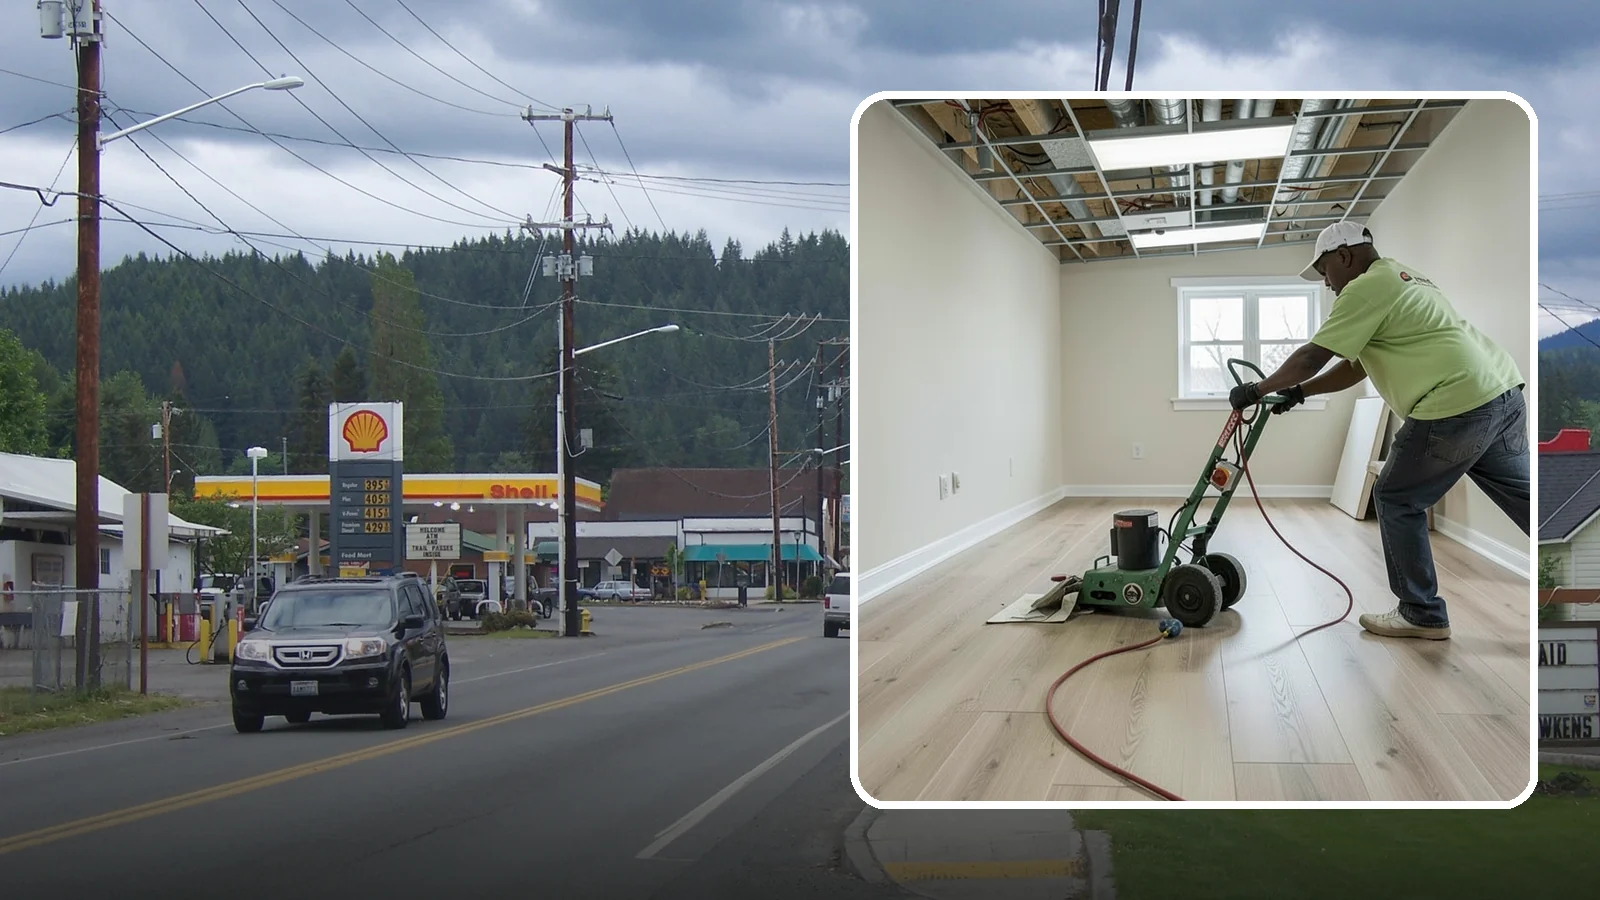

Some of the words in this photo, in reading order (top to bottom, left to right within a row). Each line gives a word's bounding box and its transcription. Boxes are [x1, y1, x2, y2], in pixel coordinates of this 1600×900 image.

[365, 480, 384, 490] 395
[490, 484, 547, 499] Shell
[365, 494, 384, 504] 405
[365, 508, 384, 518] 415
[365, 522, 384, 532] 429
